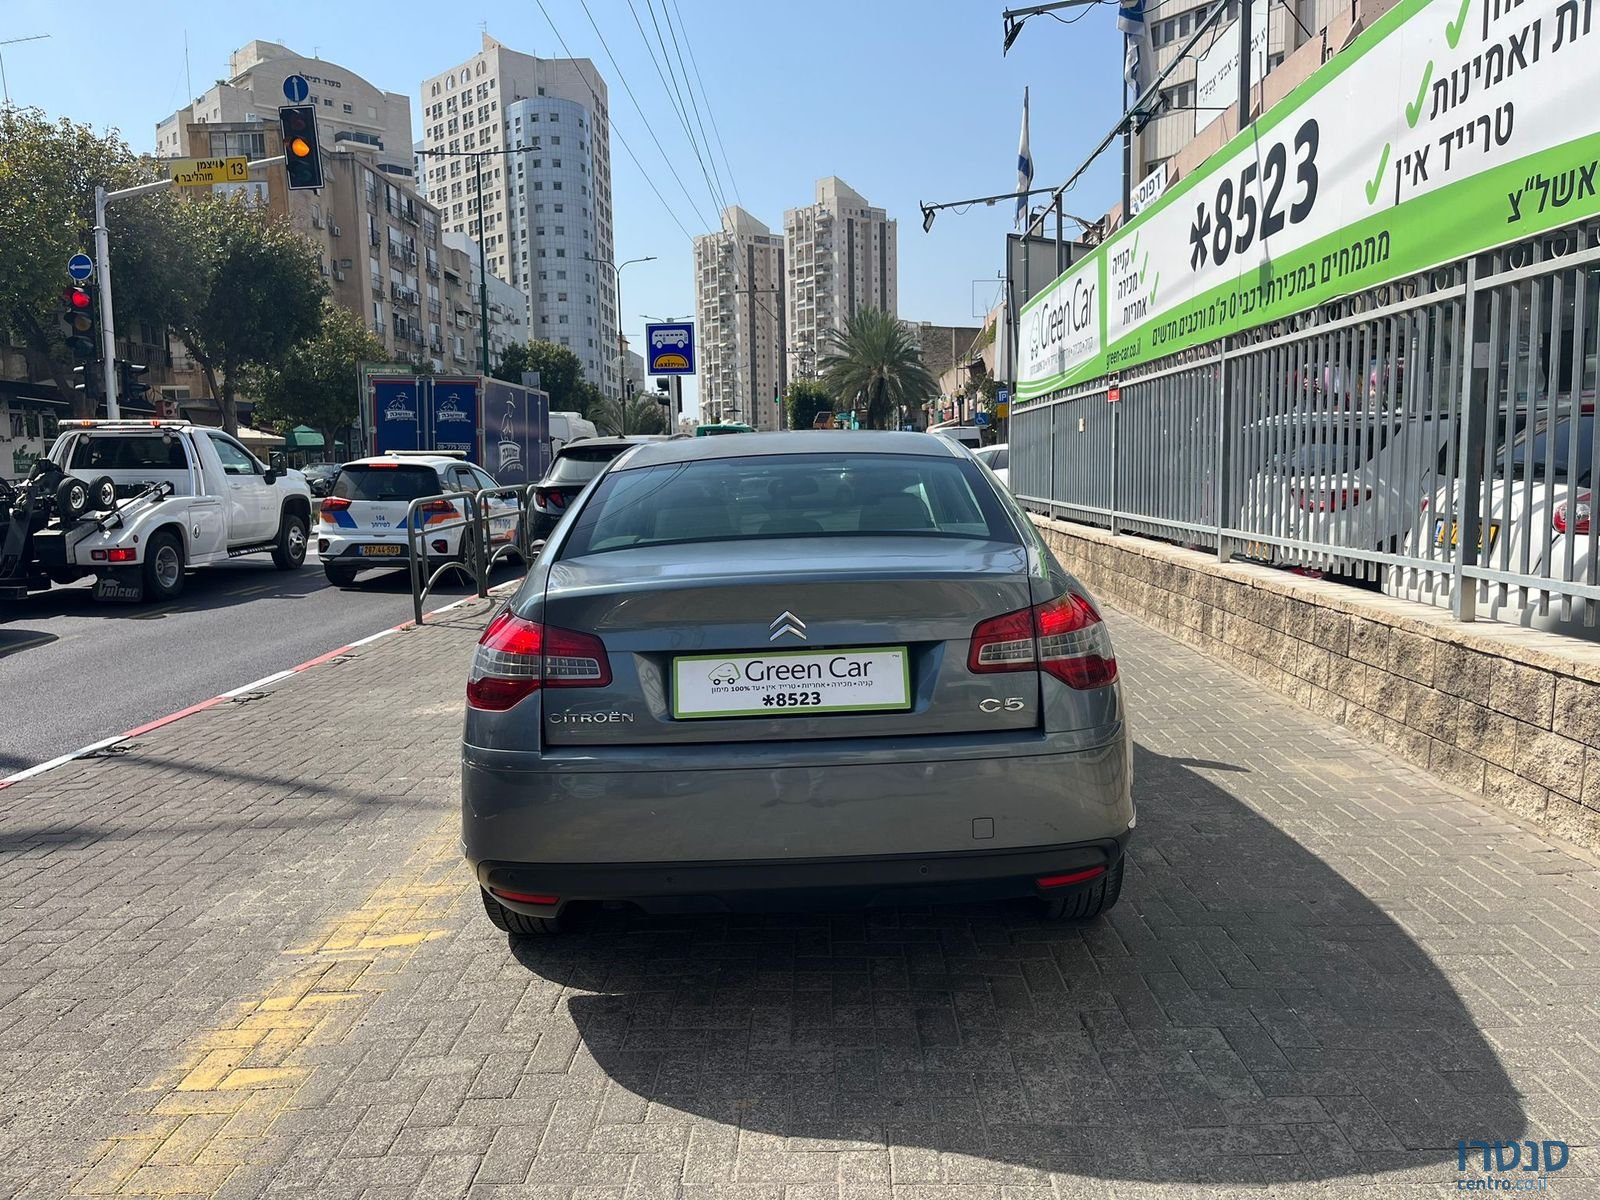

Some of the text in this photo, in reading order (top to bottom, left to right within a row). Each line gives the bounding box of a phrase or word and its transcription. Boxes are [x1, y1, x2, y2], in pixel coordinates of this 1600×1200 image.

[1429, 18, 1542, 121] ואמינות
[196, 160, 219, 173] ויצמן
[1394, 101, 1514, 206] טרייד אין
[181, 170, 214, 183] מוהליבר
[230, 162, 244, 176] 13
[1139, 172, 1161, 204] דפוס
[1507, 160, 1600, 224] אשל"צ
[1112, 248, 1130, 276] קנייה
[1321, 230, 1391, 282] מתמחים
[1117, 271, 1138, 301] מכירה
[1266, 262, 1316, 306] במכירת
[1041, 277, 1096, 350] Green Car
[1123, 296, 1147, 326] אחריות
[1229, 291, 1237, 320] 0
[1239, 285, 1263, 315] רכבי
[1152, 320, 1177, 347] חדשים
[1179, 308, 1206, 337] ורכבים
[1106, 336, 1141, 370] green-car.co.il
[744, 656, 873, 682] Green Car
[711, 686, 729, 694] מימון
[548, 711, 635, 724] CITROËN
[979, 697, 1025, 713] C5
